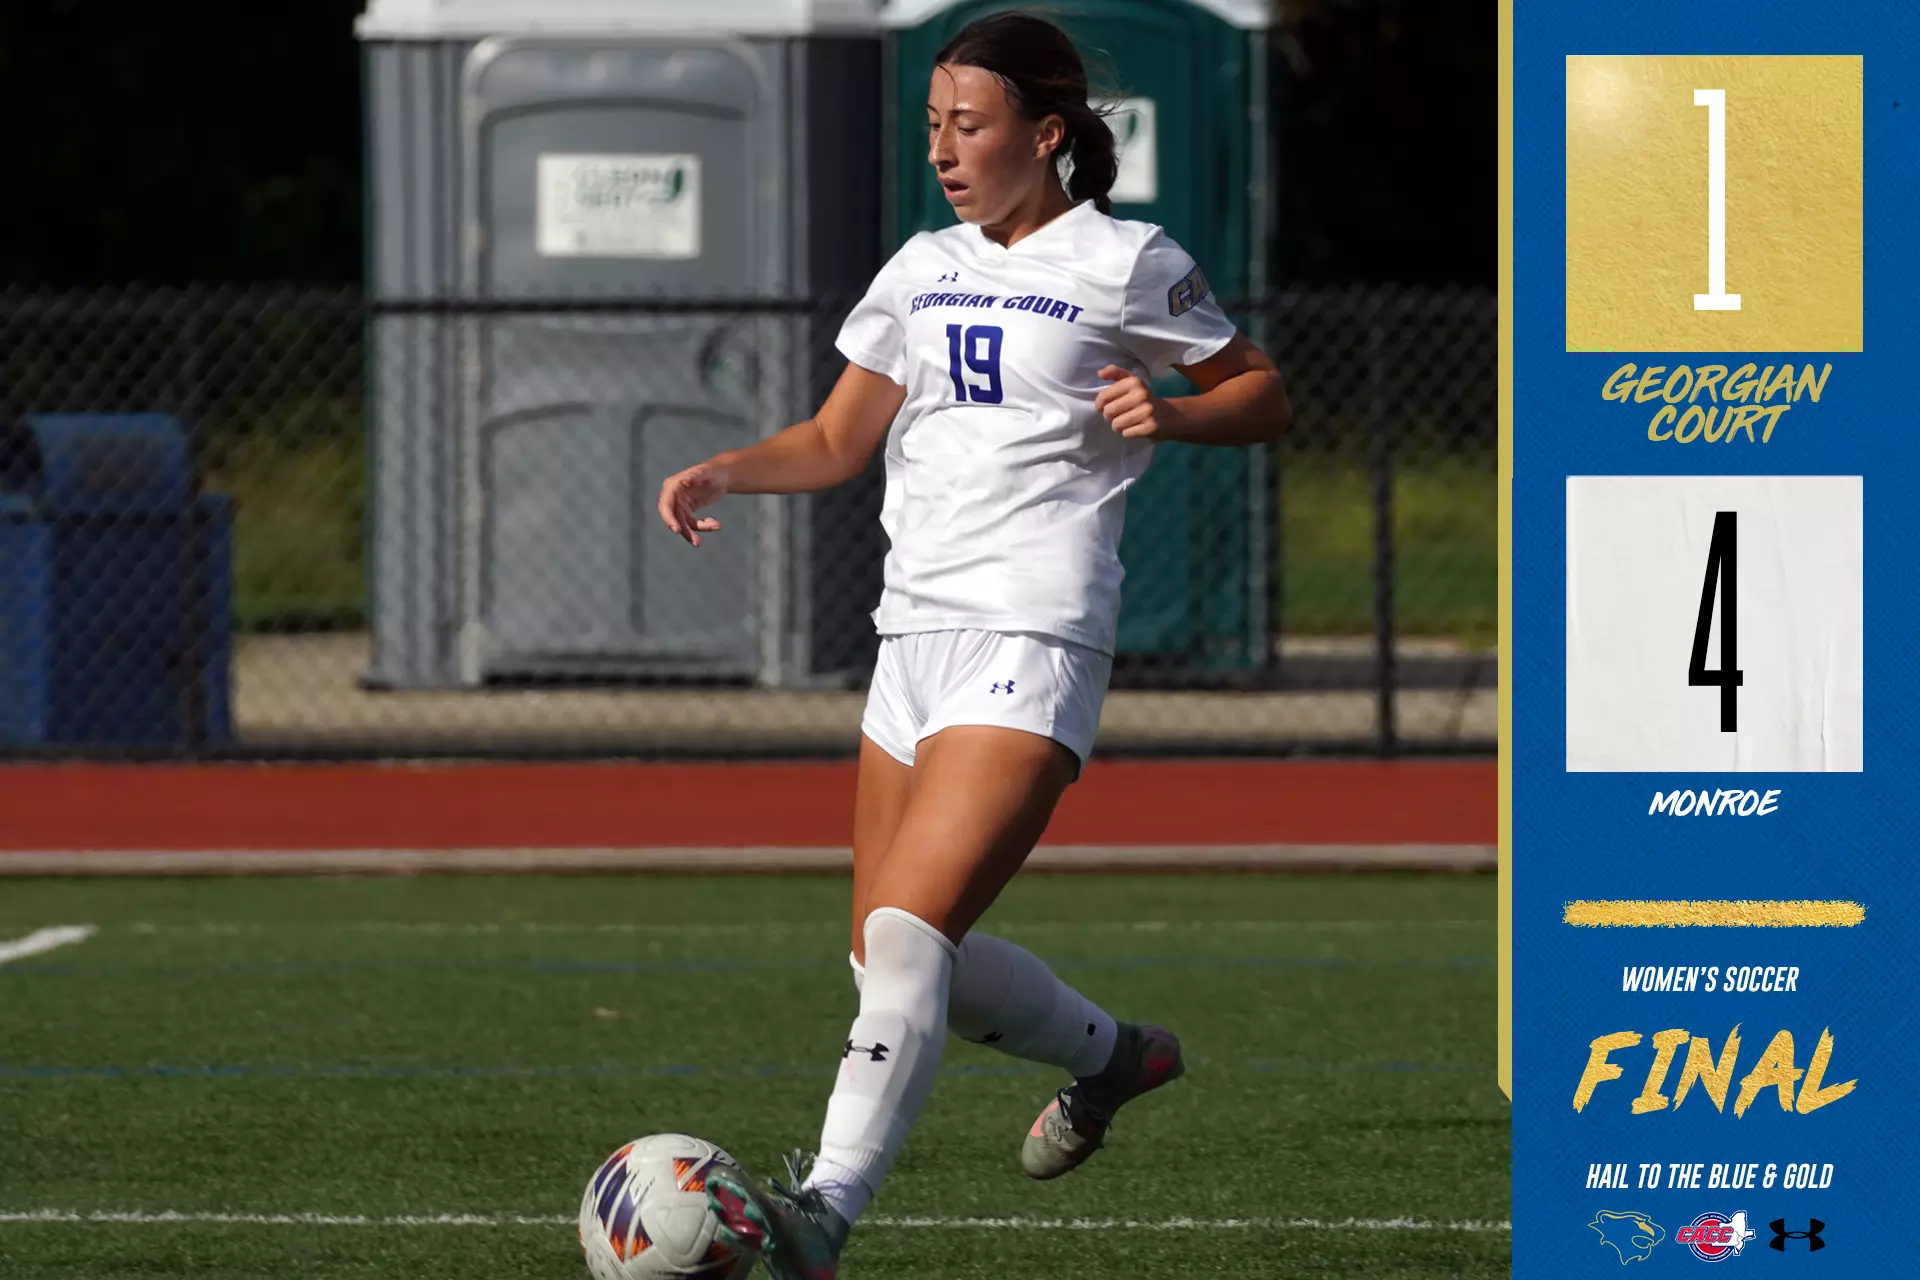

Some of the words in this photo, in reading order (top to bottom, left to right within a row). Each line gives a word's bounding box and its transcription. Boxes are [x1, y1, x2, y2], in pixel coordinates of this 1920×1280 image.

[910, 292, 1000, 316] GEORGIAN
[1002, 295, 1084, 324] COURT
[946, 323, 1004, 404] 19
